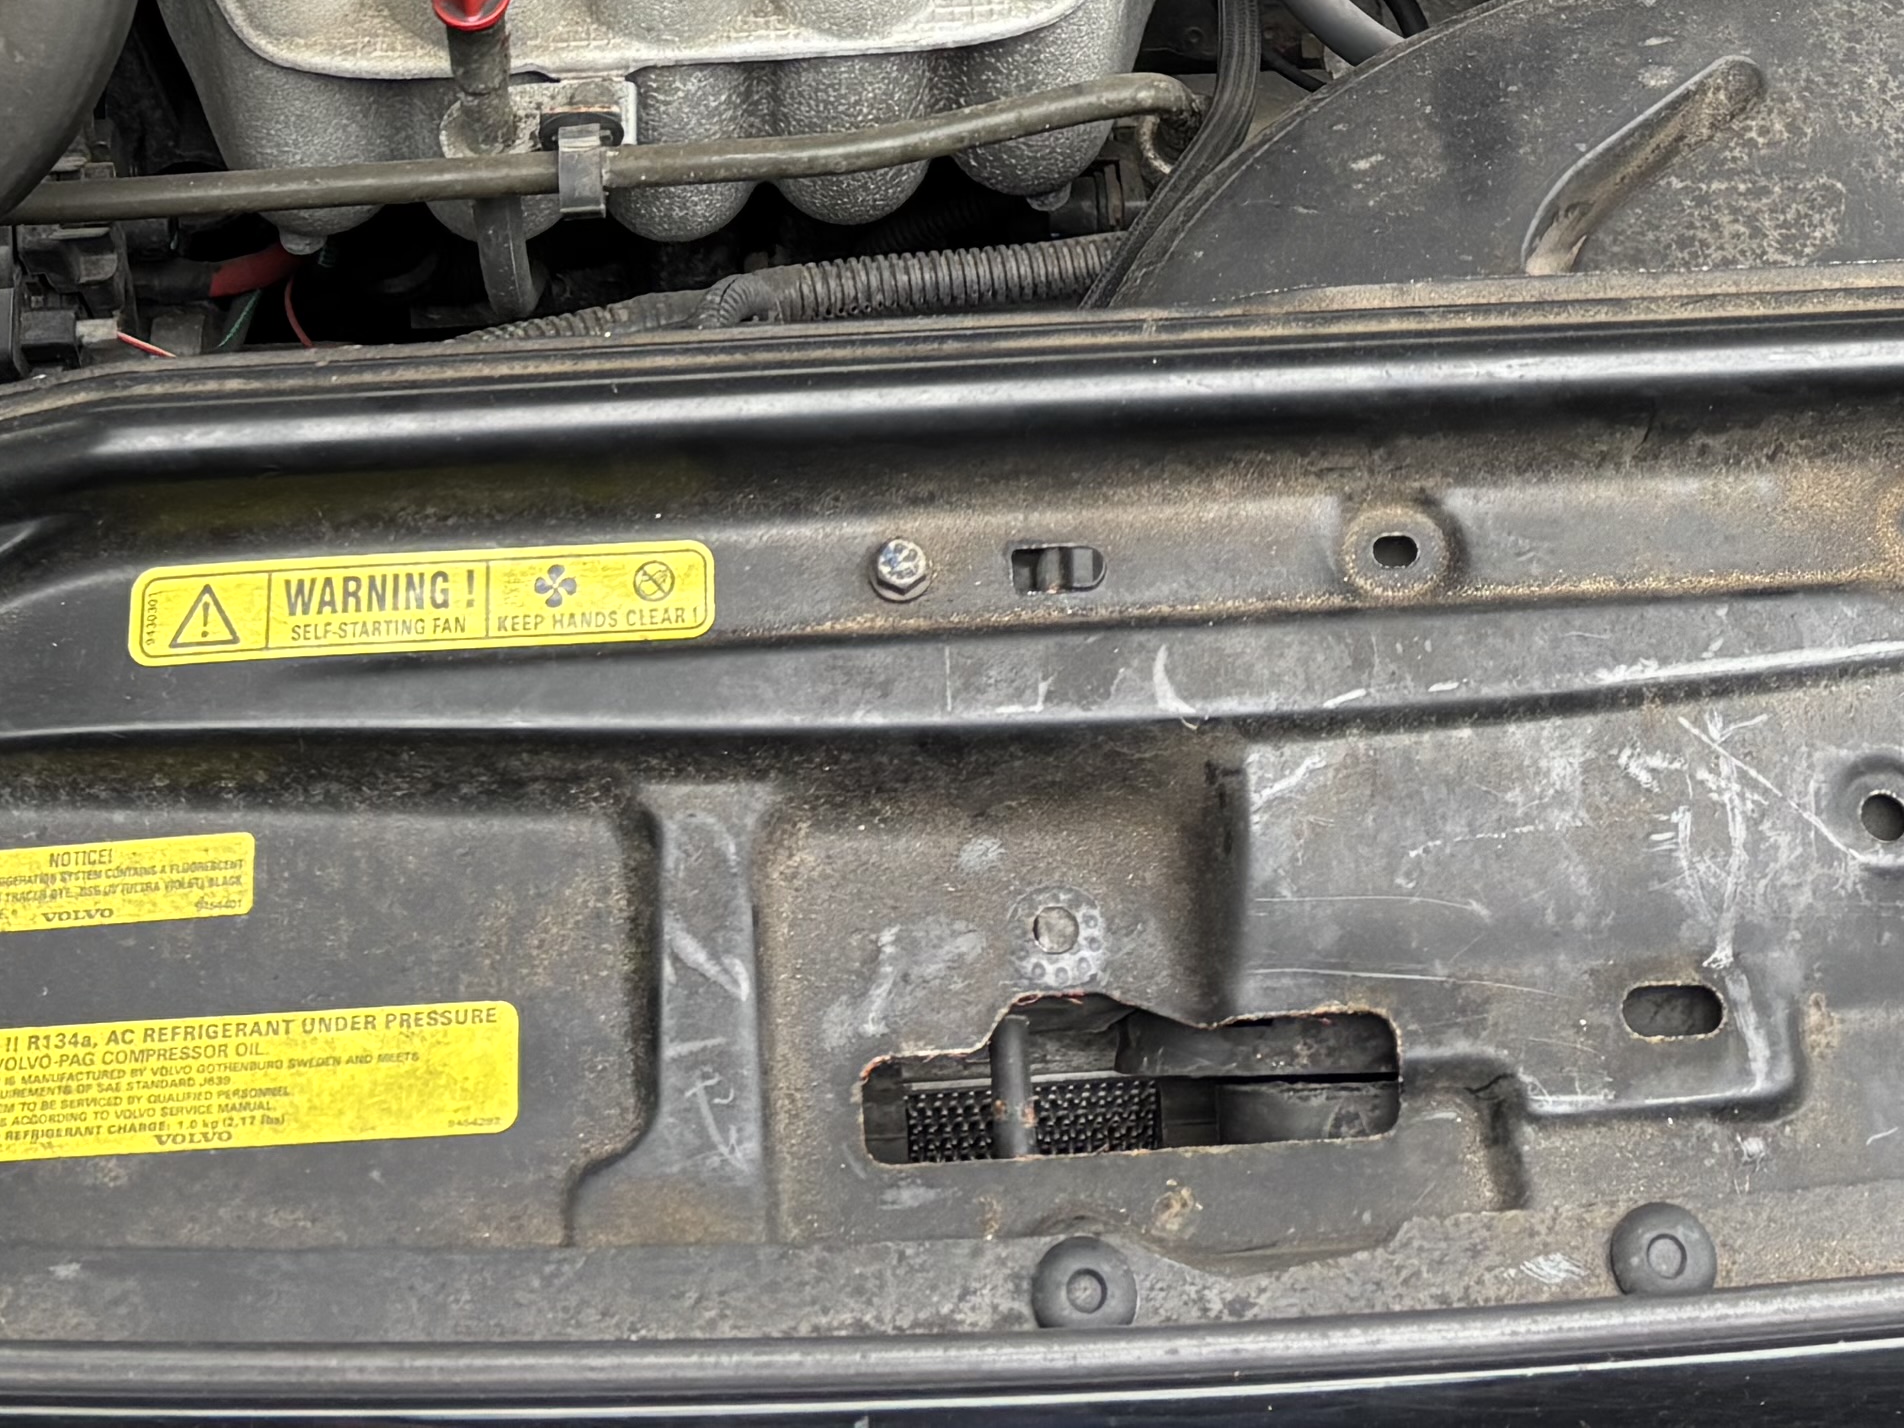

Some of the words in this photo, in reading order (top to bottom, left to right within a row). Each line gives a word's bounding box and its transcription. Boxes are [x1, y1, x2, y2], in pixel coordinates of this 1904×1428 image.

[284, 570, 450, 616] WARNING
[291, 617, 425, 642] SELF-STARTING
[433, 616, 466, 634] FAN
[497, 614, 545, 632] KEEP
[552, 611, 618, 630] HANDS
[626, 607, 685, 626] CLEAR
[49, 848, 113, 868] NOTICE!
[42, 908, 114, 922] VOLVO
[6, 1036, 19, 1053] !!
[27, 1032, 98, 1051] R134a,
[105, 1029, 135, 1046] AC
[143, 1019, 295, 1044] REFRIGERANT
[302, 1014, 377, 1034] UNDER
[385, 1007, 497, 1030] PRESSURE
[102, 1044, 228, 1065] COMPRESSOR
[5, 1077, 16, 1086] IS
[21, 1068, 126, 1085] MANUFACTURED
[130, 1067, 147, 1077] BY
[150, 1065, 192, 1076] VOLVO
[196, 1059, 284, 1073] GOTHENBURG
[288, 1056, 341, 1069] SWEDEN
[346, 1054, 374, 1065] AND
[377, 1052, 420, 1063] MEETS
[76, 1084, 94, 1093] OF
[97, 1081, 121, 1092] SAE
[126, 1077, 195, 1091] STANDARD
[199, 1076, 231, 1087] J639
[20, 1102, 37, 1111] TO
[40, 1100, 56, 1110] BE
[60, 1095, 122, 1109] SERVICED
[127, 1095, 143, 1105] BY
[147, 1091, 213, 1104] QUALIFIED
[11, 1112, 88, 1126] ACCORDING
[93, 1110, 109, 1120] TO
[114, 1108, 156, 1119] VOLVO
[160, 1104, 214, 1117] SERVICE
[5, 1125, 102, 1142] REFRIGERANT
[202, 1119, 219, 1131] kg
[154, 1130, 232, 1146] VOLVO
